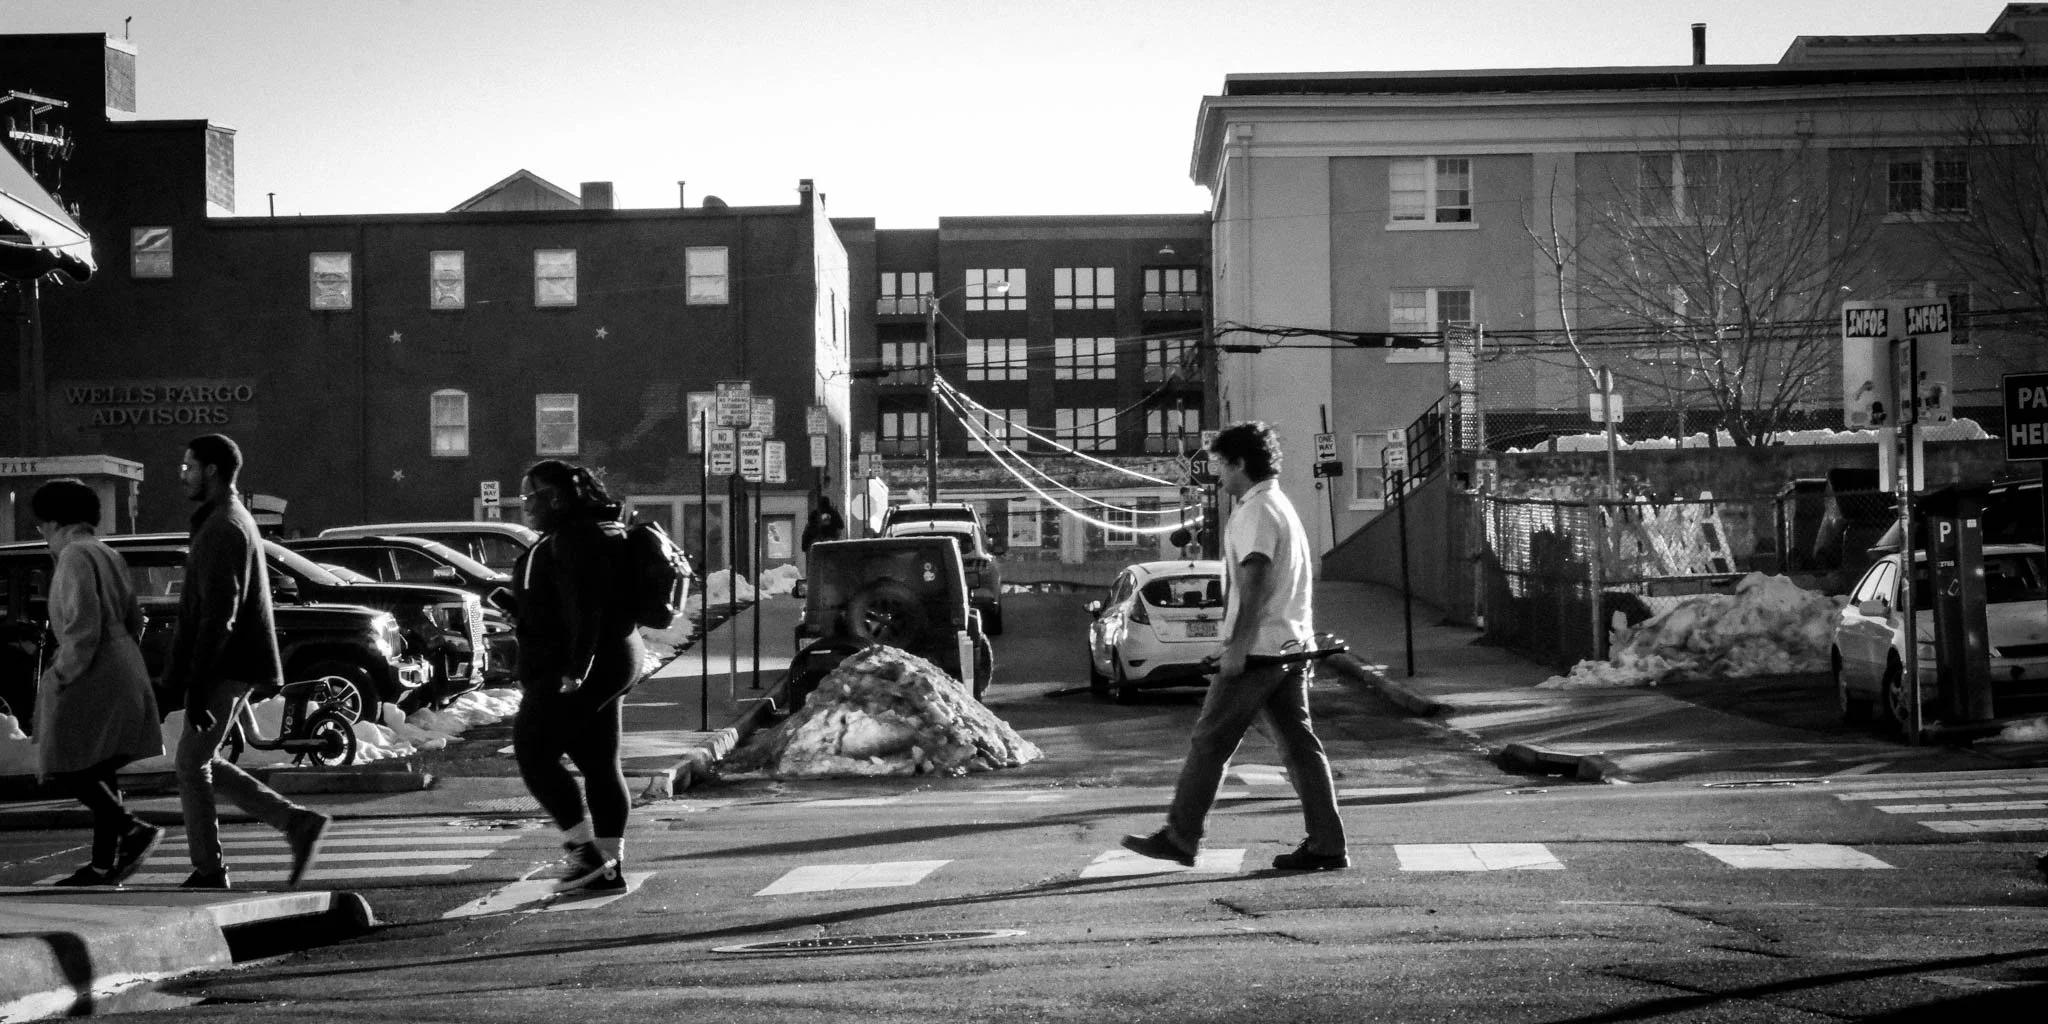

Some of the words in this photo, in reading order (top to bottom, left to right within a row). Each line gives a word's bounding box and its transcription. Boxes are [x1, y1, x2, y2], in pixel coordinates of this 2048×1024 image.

[66, 385, 157, 403] WELLS
[165, 384, 253, 402] FARGO
[2018, 386, 2048, 409] PA
[92, 405, 230, 425] ADVISORS
[718, 433, 727, 441] NO
[1319, 435, 1333, 443] ONE
[2, 462, 37, 473] PARK
[1940, 521, 1951, 542] P
